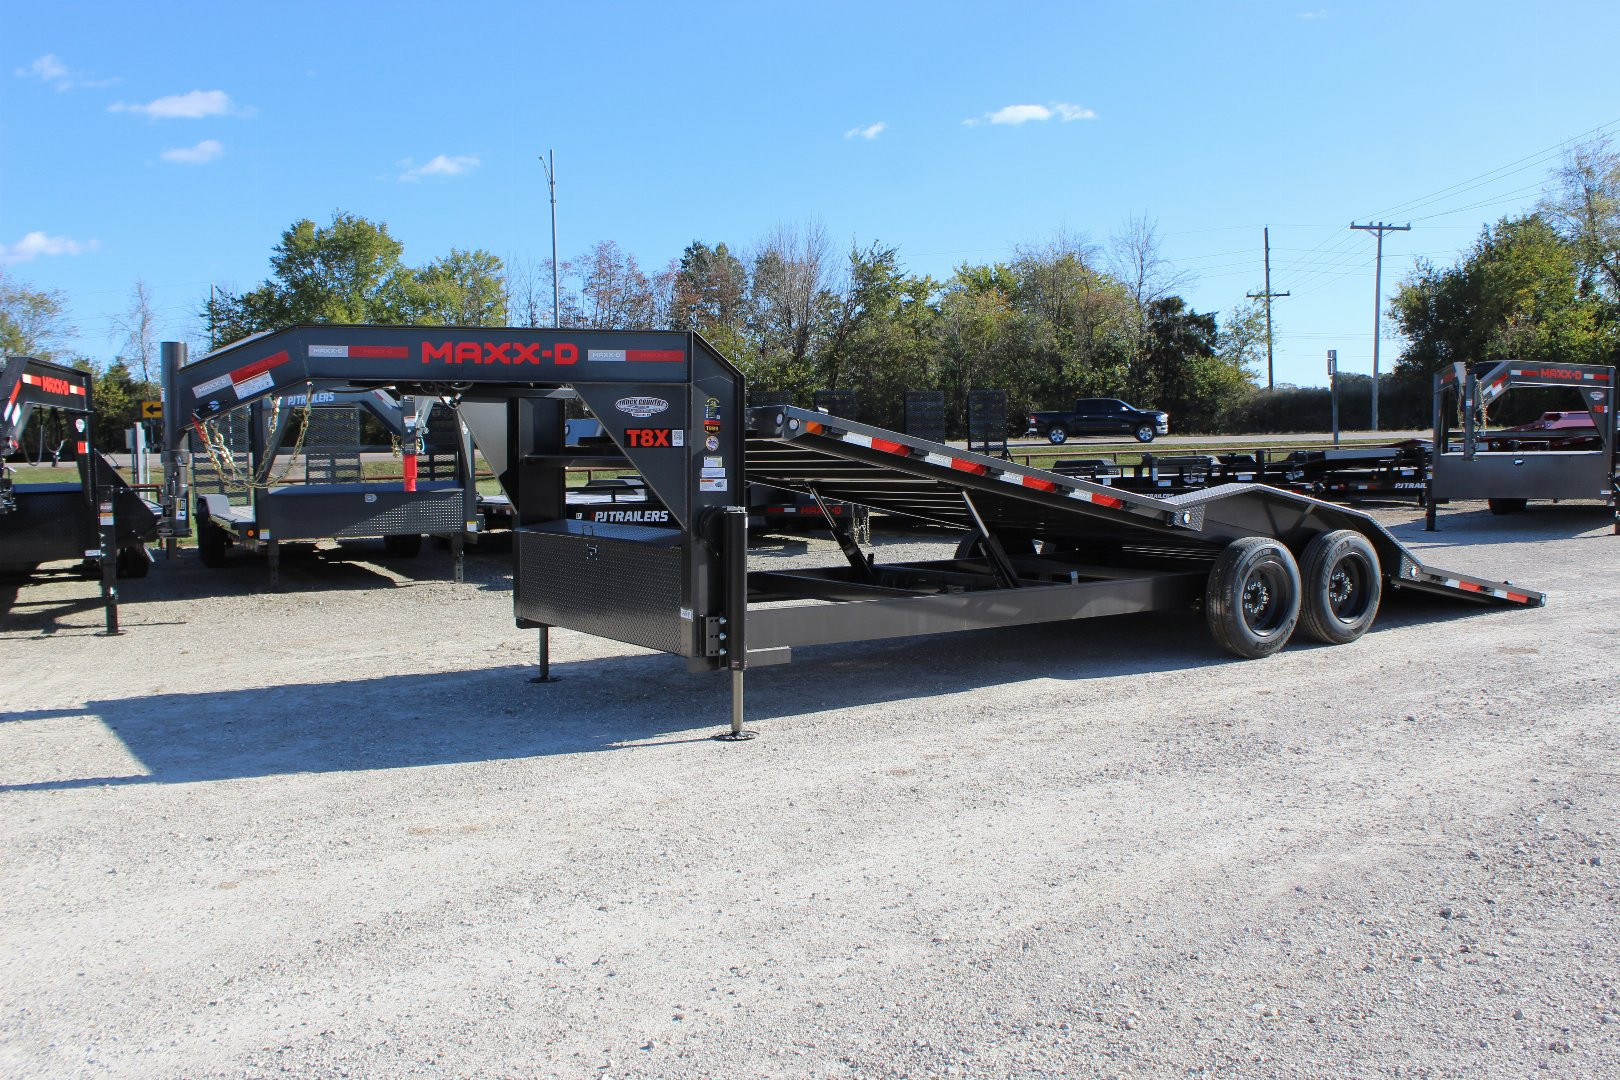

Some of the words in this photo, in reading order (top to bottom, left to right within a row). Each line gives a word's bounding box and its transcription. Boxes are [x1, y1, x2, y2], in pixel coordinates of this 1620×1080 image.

[421, 341, 579, 365] MAXX-D
[1540, 368, 1582, 380] MAXX-D
[42, 376, 69, 396] MAXX-D
[626, 429, 670, 447] T8X
